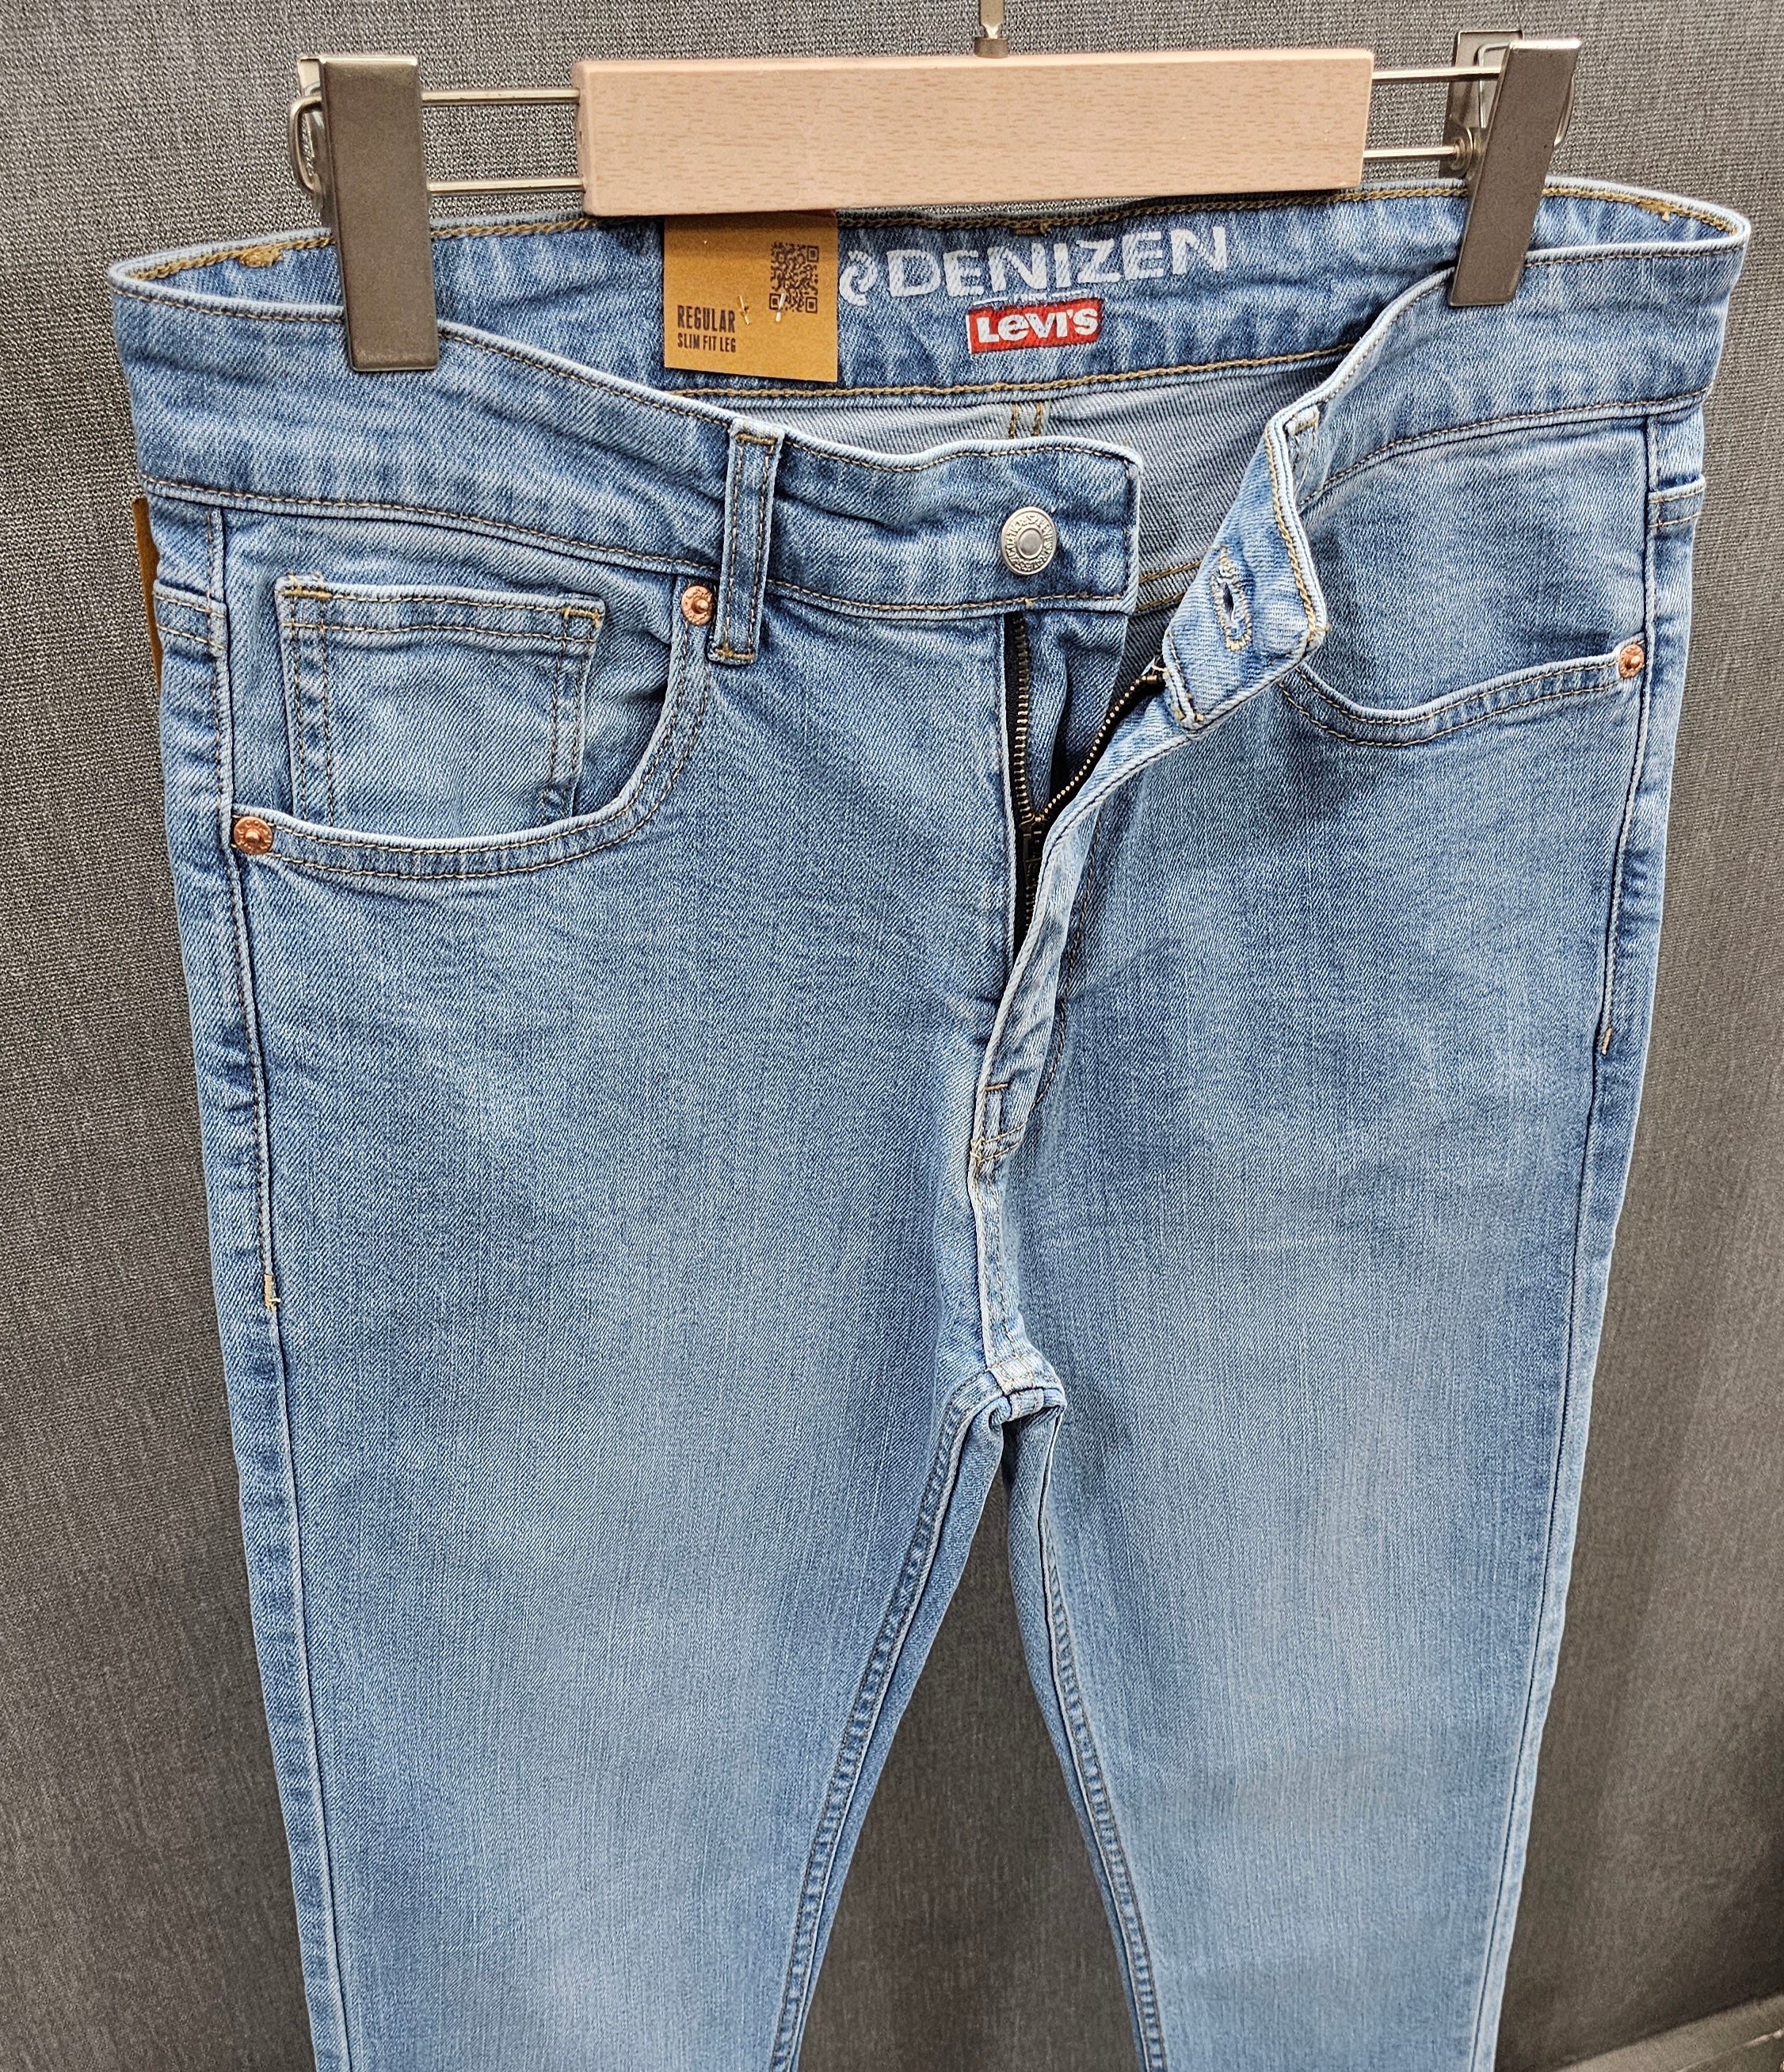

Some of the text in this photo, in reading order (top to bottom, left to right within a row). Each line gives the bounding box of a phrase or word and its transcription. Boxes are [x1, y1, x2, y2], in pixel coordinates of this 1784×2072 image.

[886, 226, 1227, 297] DENIZEN
[677, 304, 736, 333] REGULAR
[677, 332, 736, 353] SLIM FIT LEG
